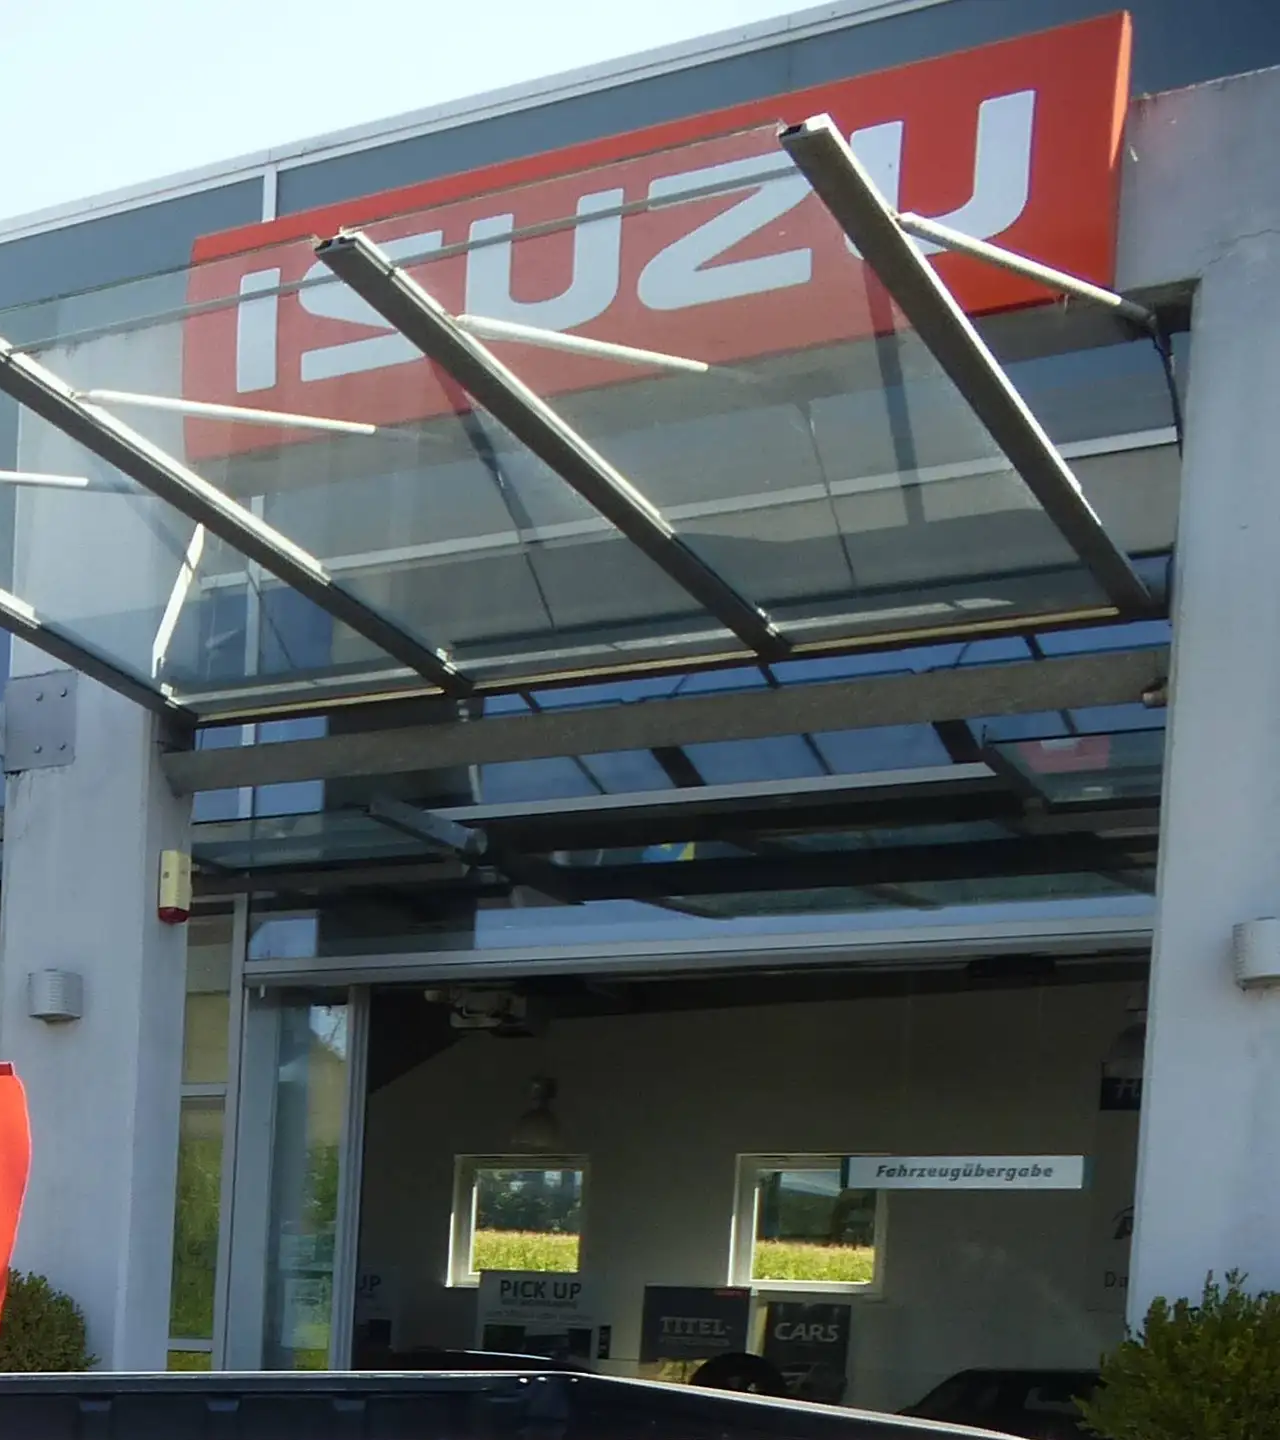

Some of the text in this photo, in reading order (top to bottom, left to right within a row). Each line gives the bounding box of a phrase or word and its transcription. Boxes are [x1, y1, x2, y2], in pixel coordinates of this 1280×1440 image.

[235, 90, 1037, 394] ISUZU
[875, 1163, 1054, 1182] Fahrzeugübergabe
[500, 1279, 582, 1300] PICK UP
